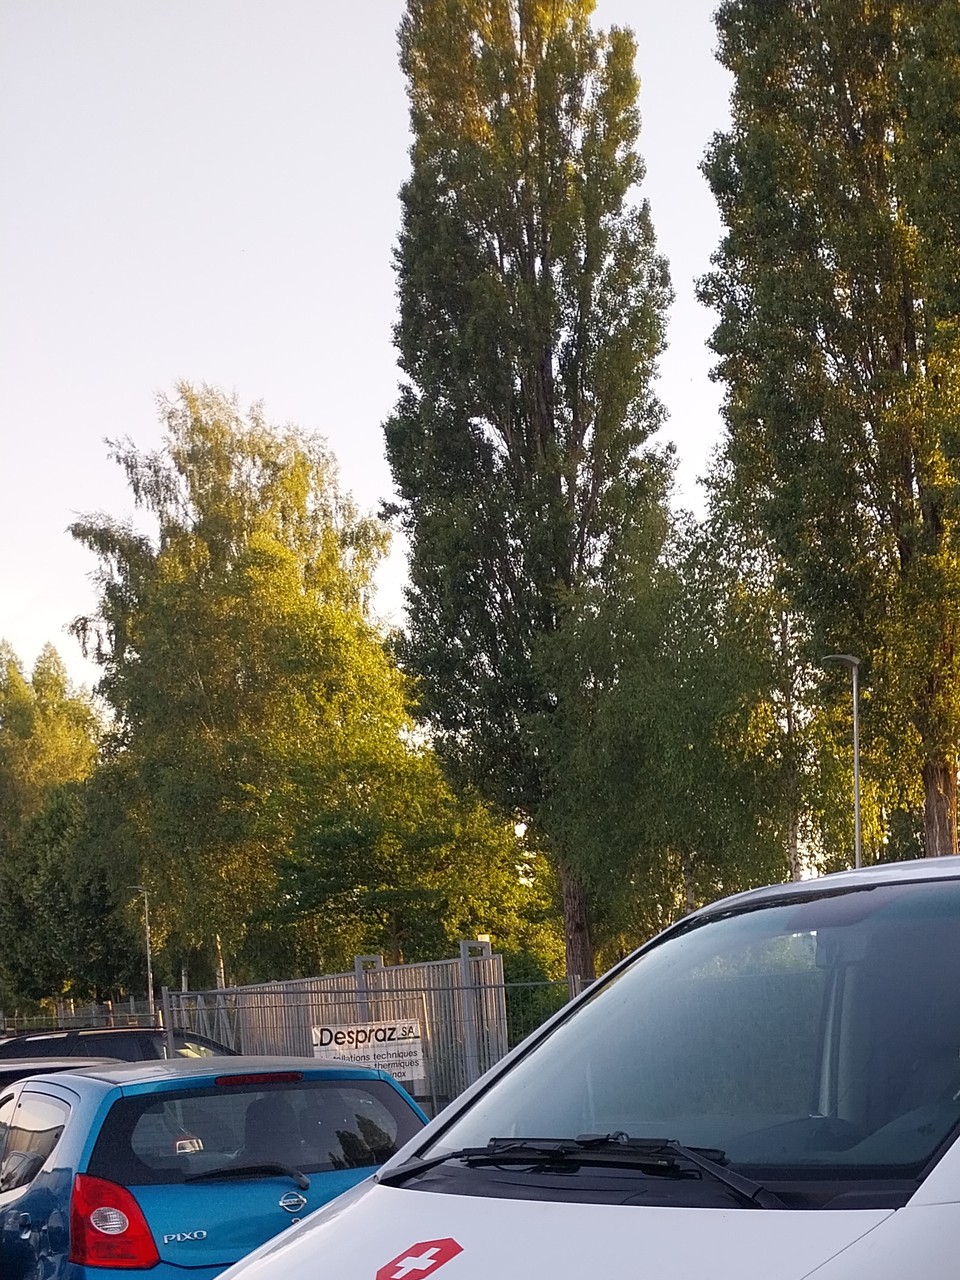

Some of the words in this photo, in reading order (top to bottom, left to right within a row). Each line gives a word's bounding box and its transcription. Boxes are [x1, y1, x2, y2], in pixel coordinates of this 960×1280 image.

[319, 1026, 397, 1049] Despraz
[400, 1025, 415, 1037] SA
[373, 1050, 418, 1061] techniques
[374, 1059, 420, 1069] thermiques
[163, 1229, 208, 1244] PIXO
